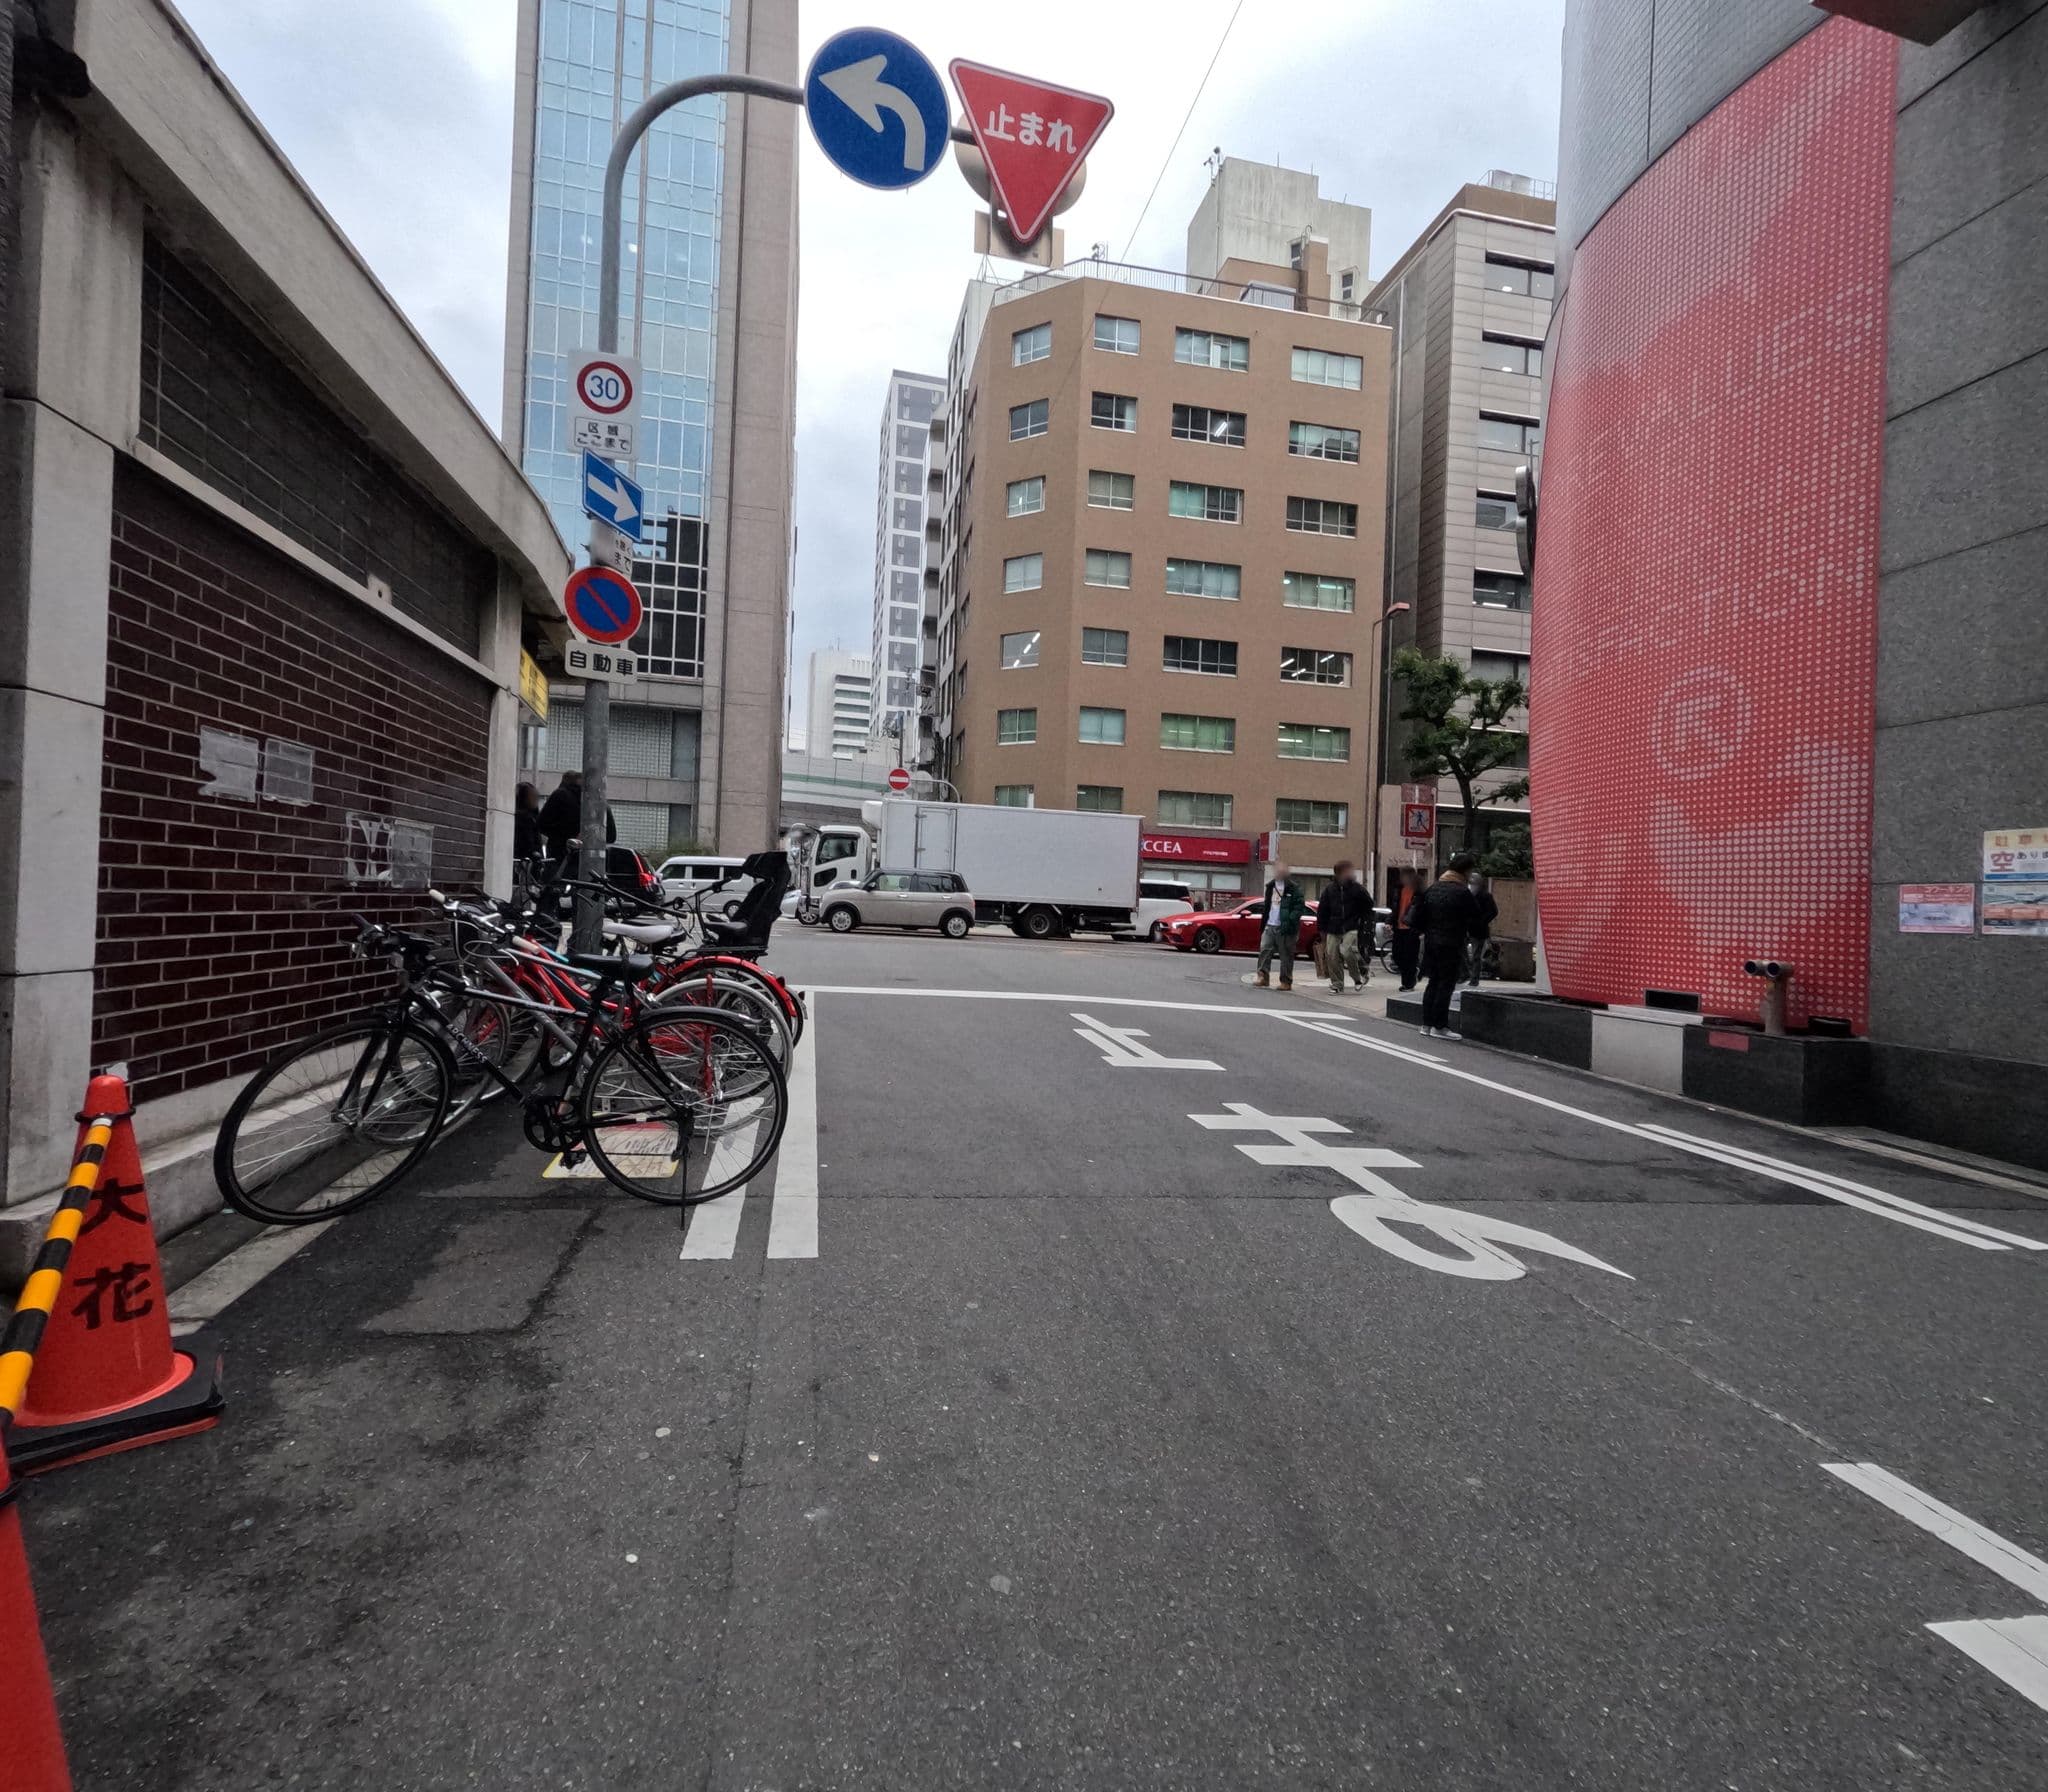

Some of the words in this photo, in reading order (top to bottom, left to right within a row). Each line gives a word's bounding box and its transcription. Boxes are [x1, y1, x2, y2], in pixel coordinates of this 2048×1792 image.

[984, 103, 1077, 154] 止まれ
[590, 375, 620, 401] 30
[577, 432, 630, 451] ここまで
[569, 649, 635, 676] 自動車
[1141, 839, 1183, 854] CCEA
